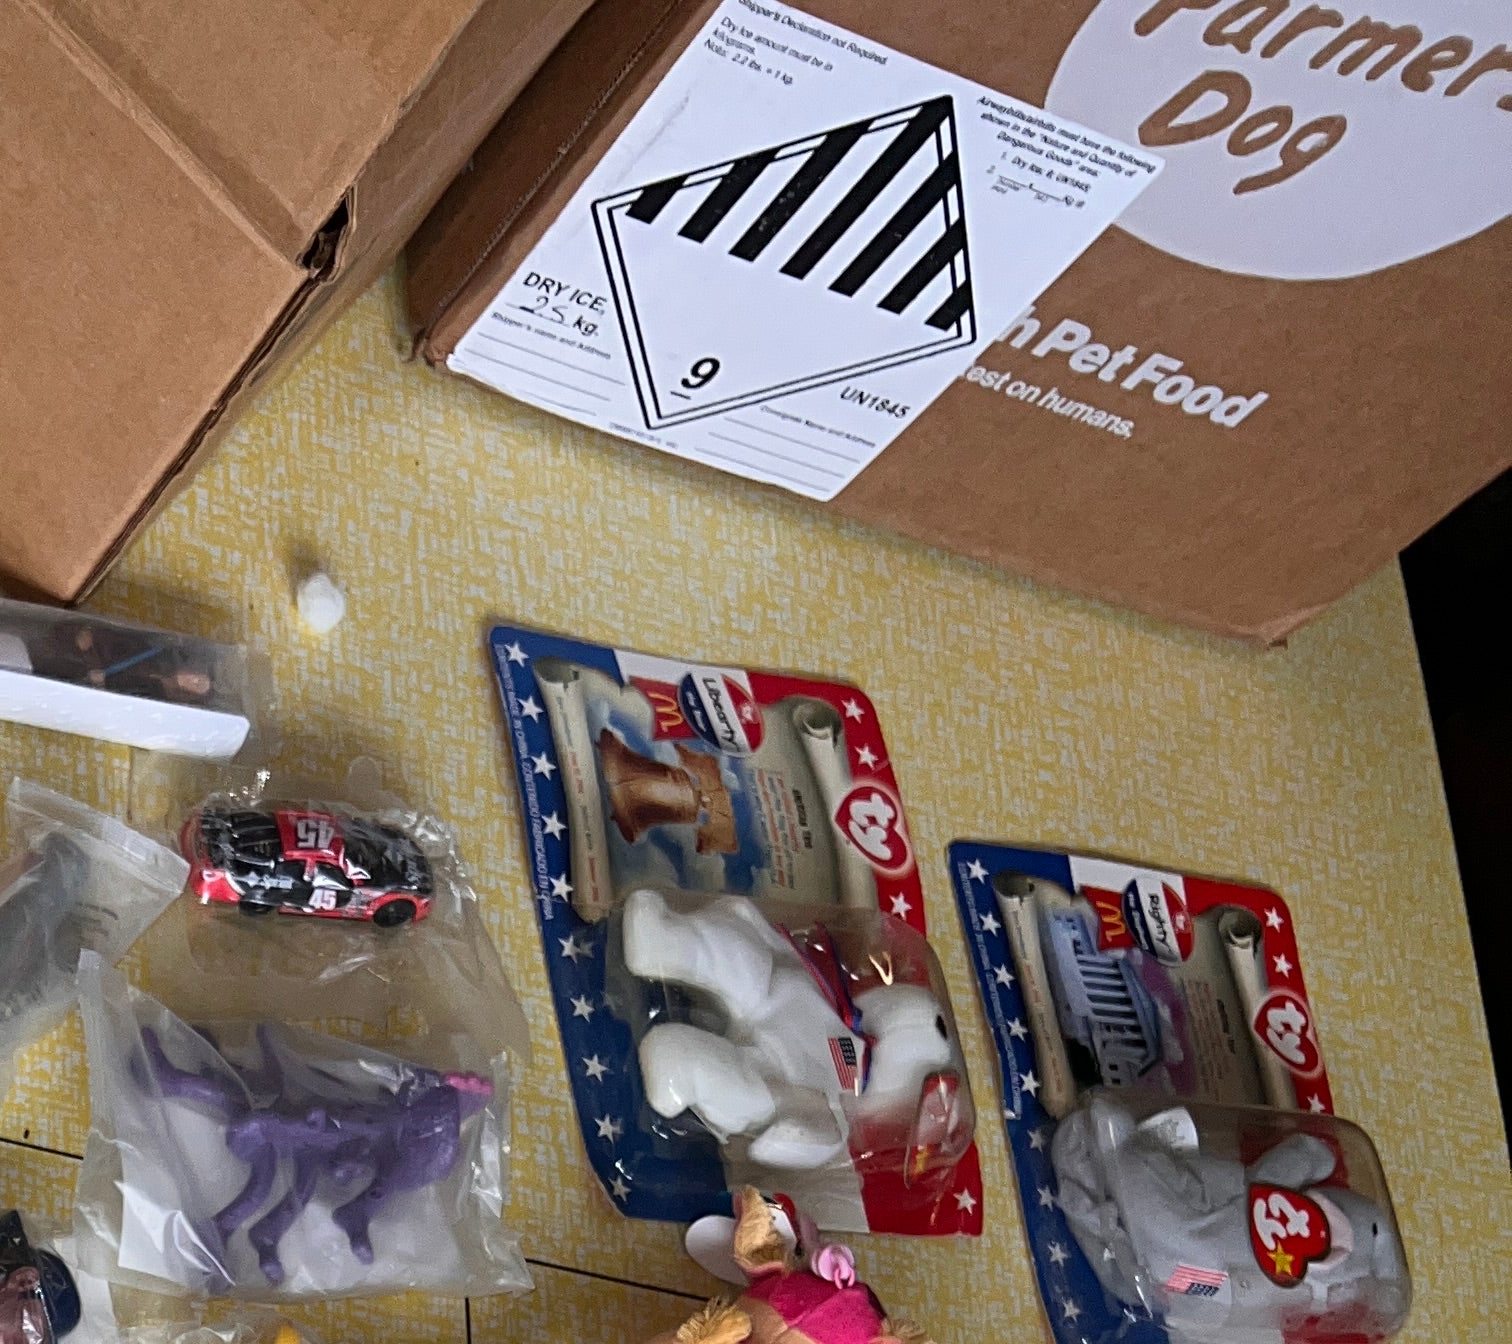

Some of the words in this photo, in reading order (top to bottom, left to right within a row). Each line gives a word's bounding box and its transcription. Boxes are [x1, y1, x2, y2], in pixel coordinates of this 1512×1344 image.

[721, 16, 737, 33] Dry
[1138, 69, 1347, 195] Dog
[523, 271, 570, 297] DRY
[681, 357, 720, 390] 9
[840, 386, 910, 418] UN1845
[966, 365, 1011, 391] est
[1005, 381, 1041, 406] on
[1037, 387, 1135, 439] humans,
[1031, 318, 1138, 382] Pet
[1120, 353, 1270, 428] Food
[702, 677, 736, 745] Libearty
[848, 793, 895, 860] ty
[1148, 893, 1169, 946] Righty
[1267, 1001, 1306, 1064] ty
